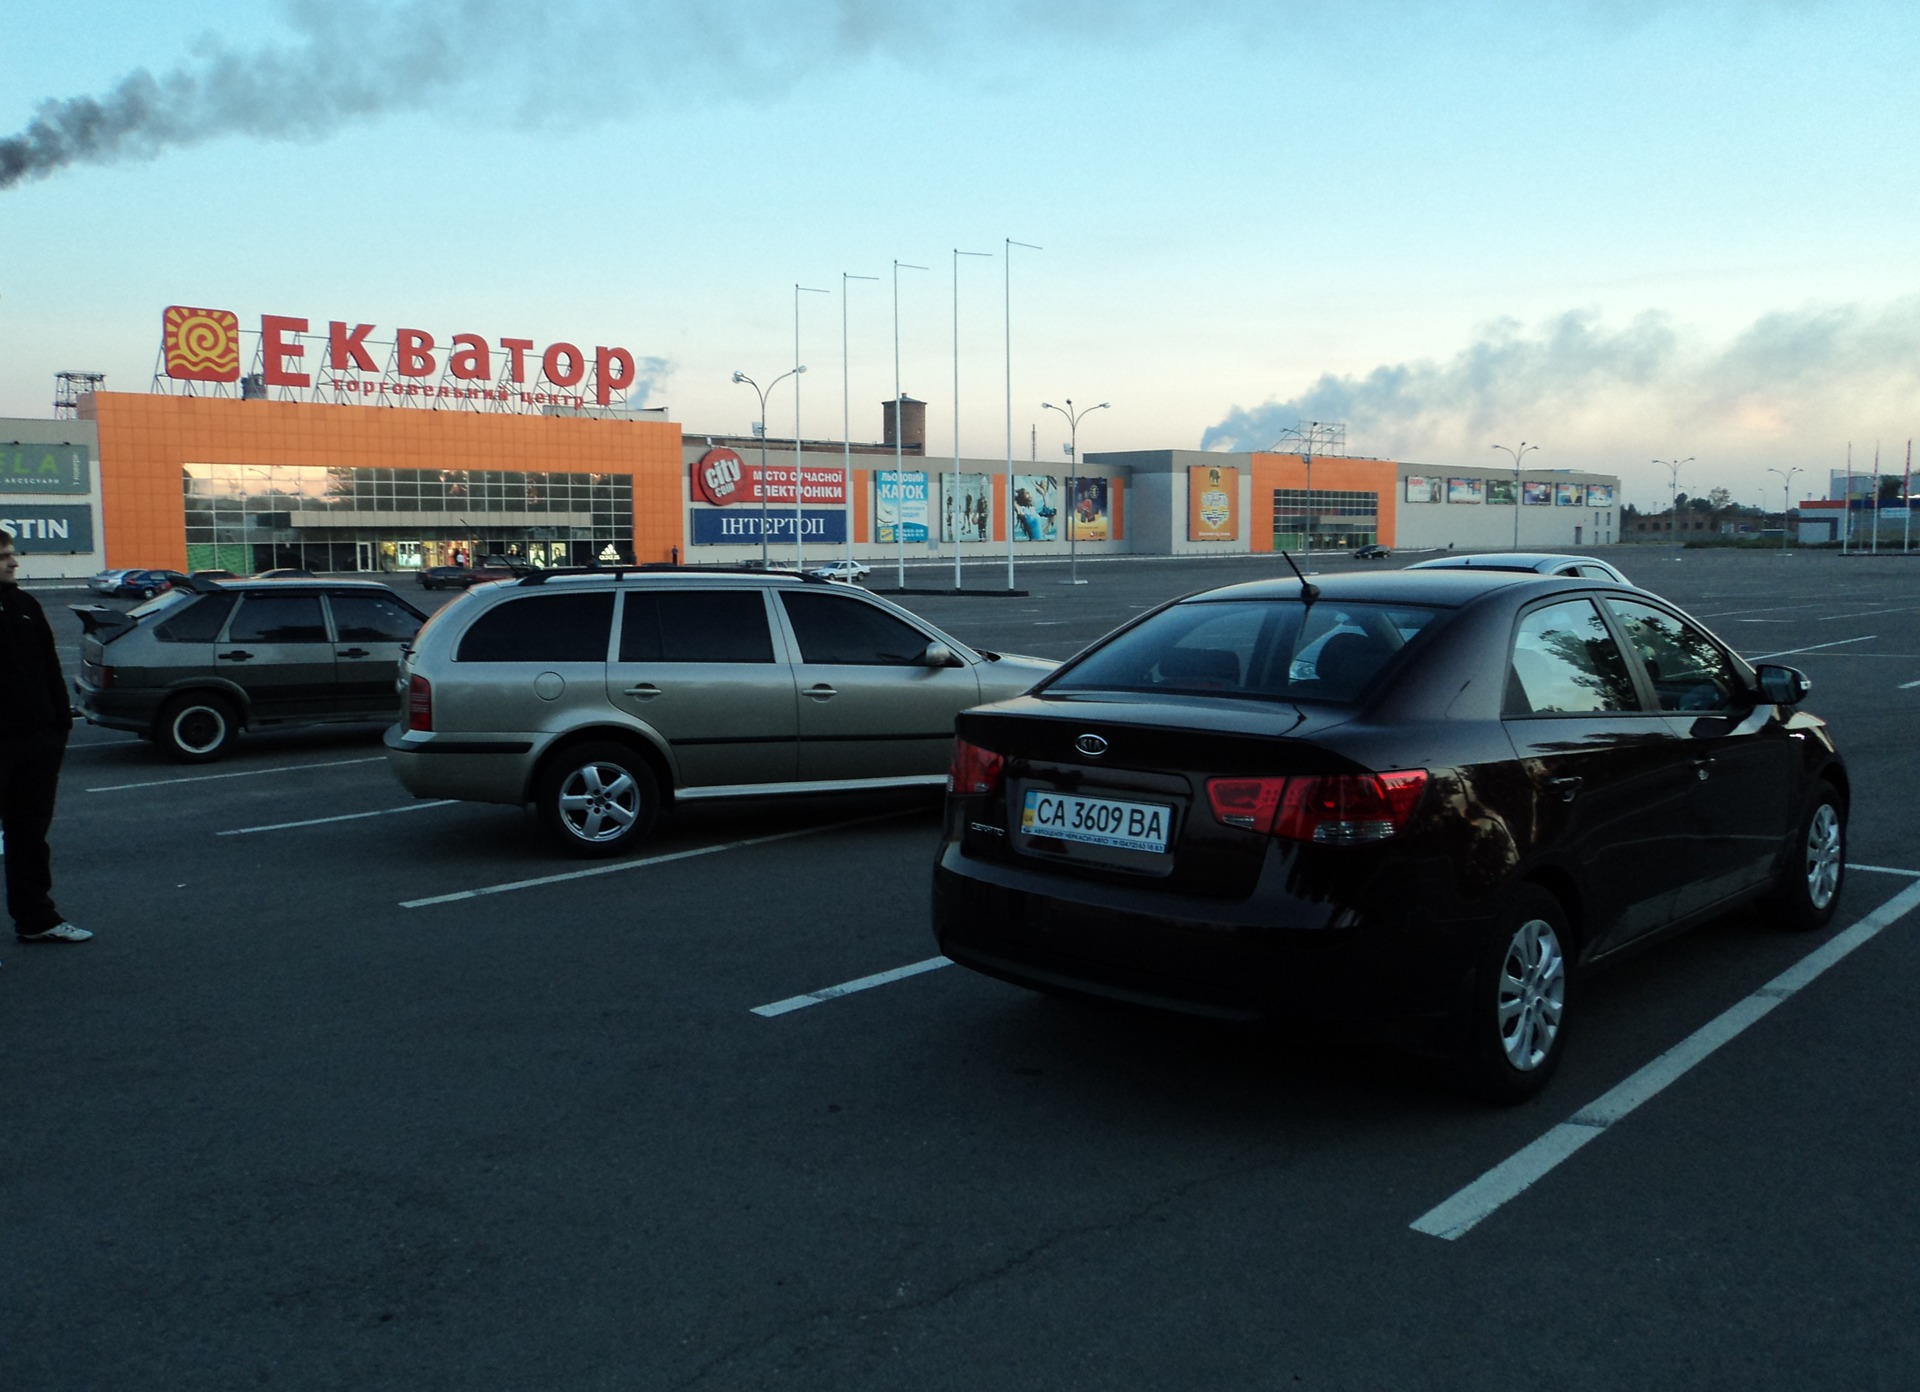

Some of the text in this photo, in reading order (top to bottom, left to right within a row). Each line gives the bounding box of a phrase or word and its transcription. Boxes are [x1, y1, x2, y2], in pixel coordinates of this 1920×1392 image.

[332, 379, 584, 410] торговельний центр
[704, 458, 741, 489] city
[753, 470, 787, 481] МСТО
[714, 481, 735, 498] com
[881, 484, 924, 499] КАТОК
[720, 518, 826, 535] ІНТЕРТОП
[1080, 739, 1102, 750] KIA
[1037, 798, 1162, 840] CA 3609 BA
